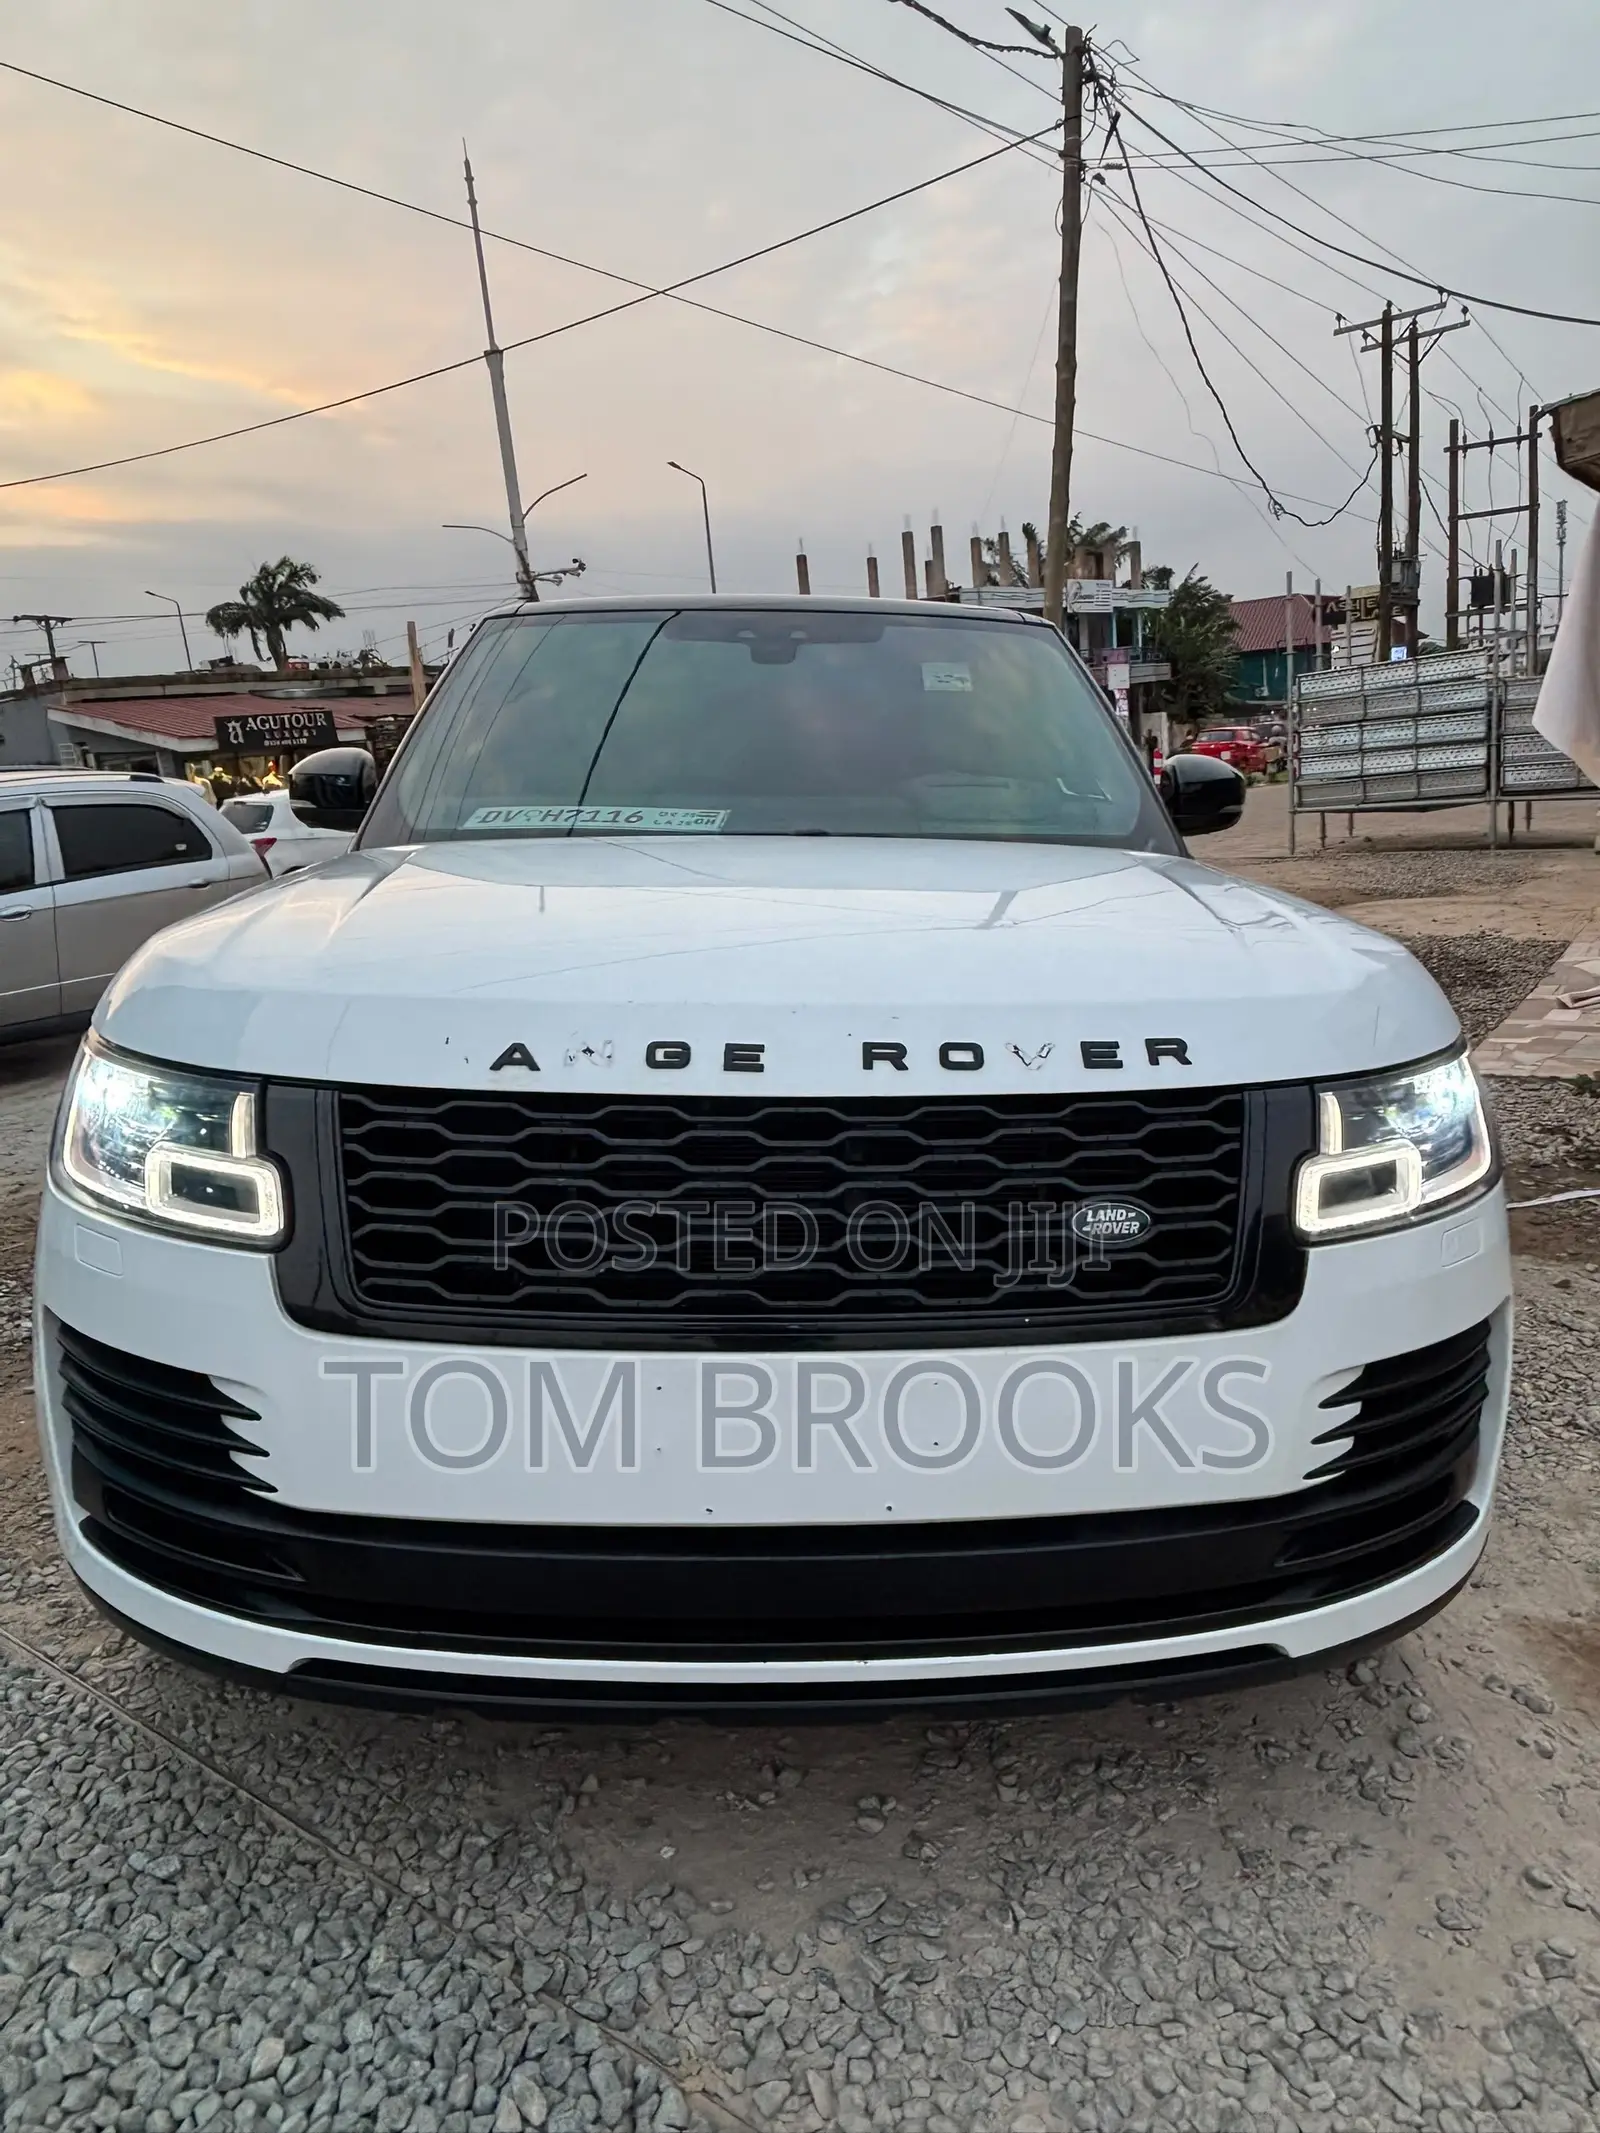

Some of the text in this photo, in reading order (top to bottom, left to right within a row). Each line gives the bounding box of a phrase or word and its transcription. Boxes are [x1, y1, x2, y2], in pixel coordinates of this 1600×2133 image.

[245, 712, 327, 731] AGUTOUR
[862, 1037, 1193, 1071] ROVER
[1086, 1209, 1127, 1222] LAND
[1090, 1221, 1140, 1235] ROVER
